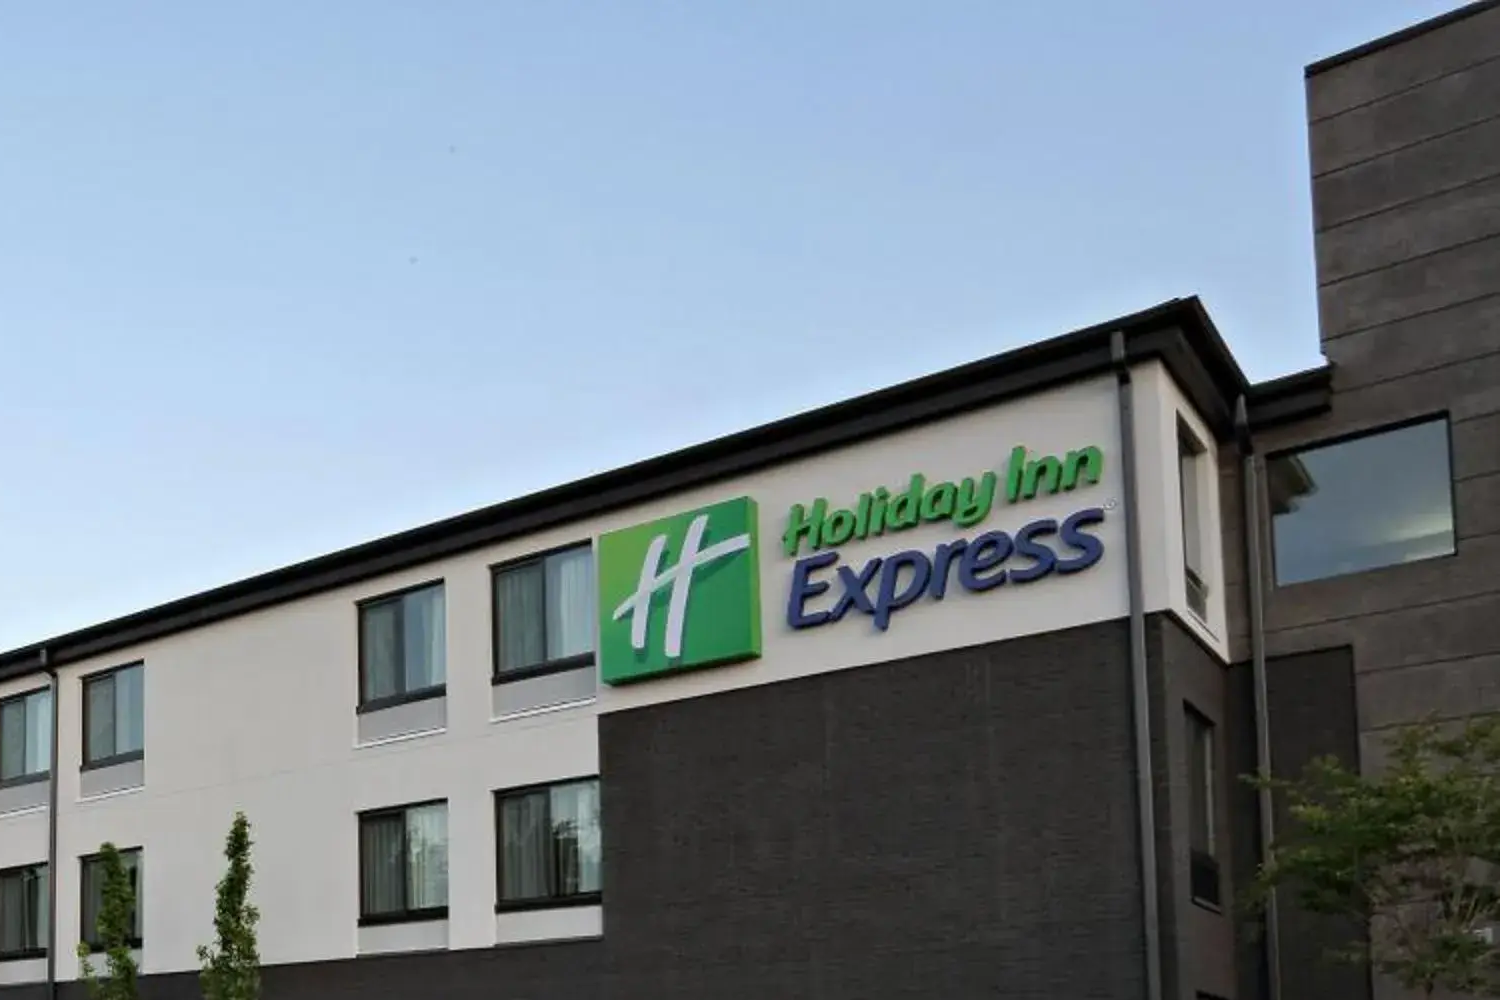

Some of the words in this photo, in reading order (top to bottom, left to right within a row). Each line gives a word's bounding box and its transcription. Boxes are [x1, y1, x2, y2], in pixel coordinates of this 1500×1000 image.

[782, 471, 996, 555] Holiday
[1006, 446, 1102, 503] Inn
[612, 515, 751, 658] H
[787, 507, 1105, 631] Express
